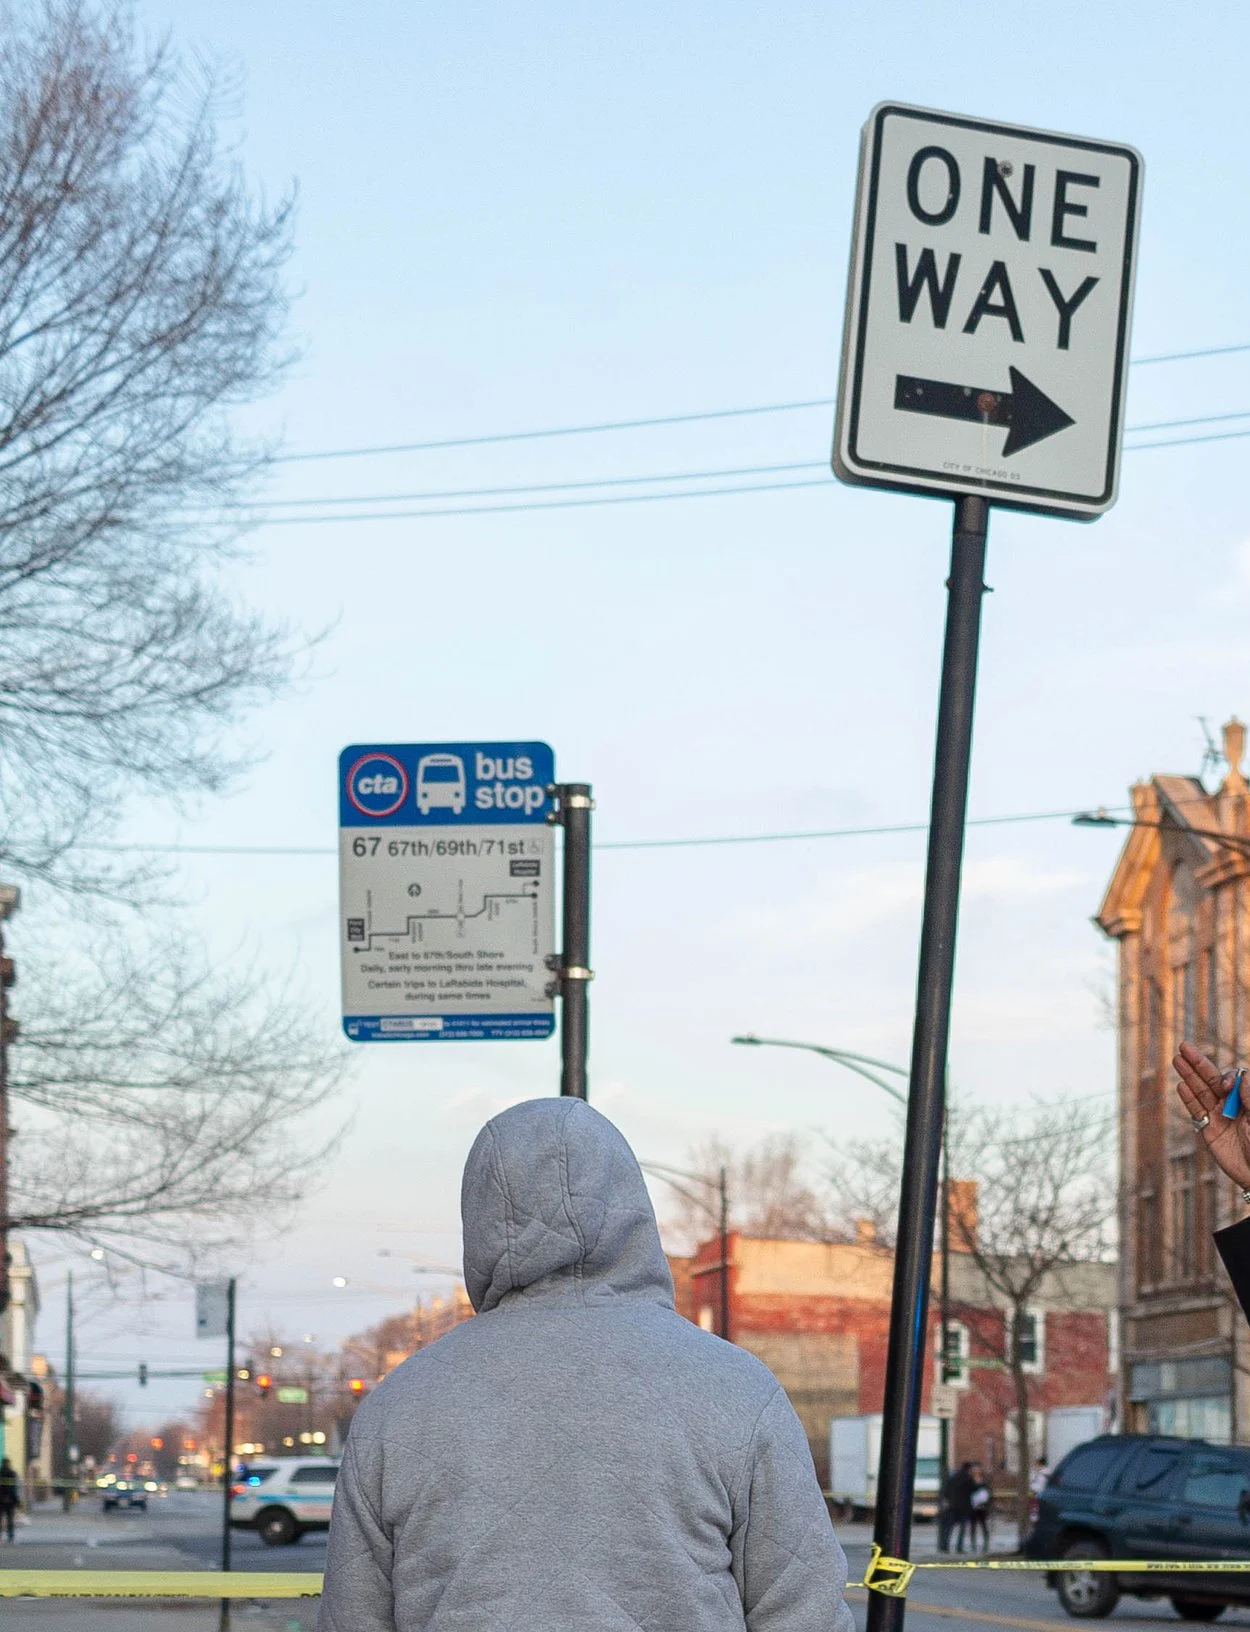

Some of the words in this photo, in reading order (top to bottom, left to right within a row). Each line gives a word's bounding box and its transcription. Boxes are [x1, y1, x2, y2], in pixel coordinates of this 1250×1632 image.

[907, 145, 1100, 253] ONE
[895, 242, 1100, 351] WAY
[475, 752, 534, 780] bus
[358, 774, 398, 794] cta
[475, 782, 545, 815] stop
[352, 837, 382, 857] 67
[387, 839, 525, 856] 67th/69th/71st
[388, 952, 409, 960] East
[411, 951, 421, 960] to
[476, 950, 505, 959] Shore
[476, 963, 494, 972] late
